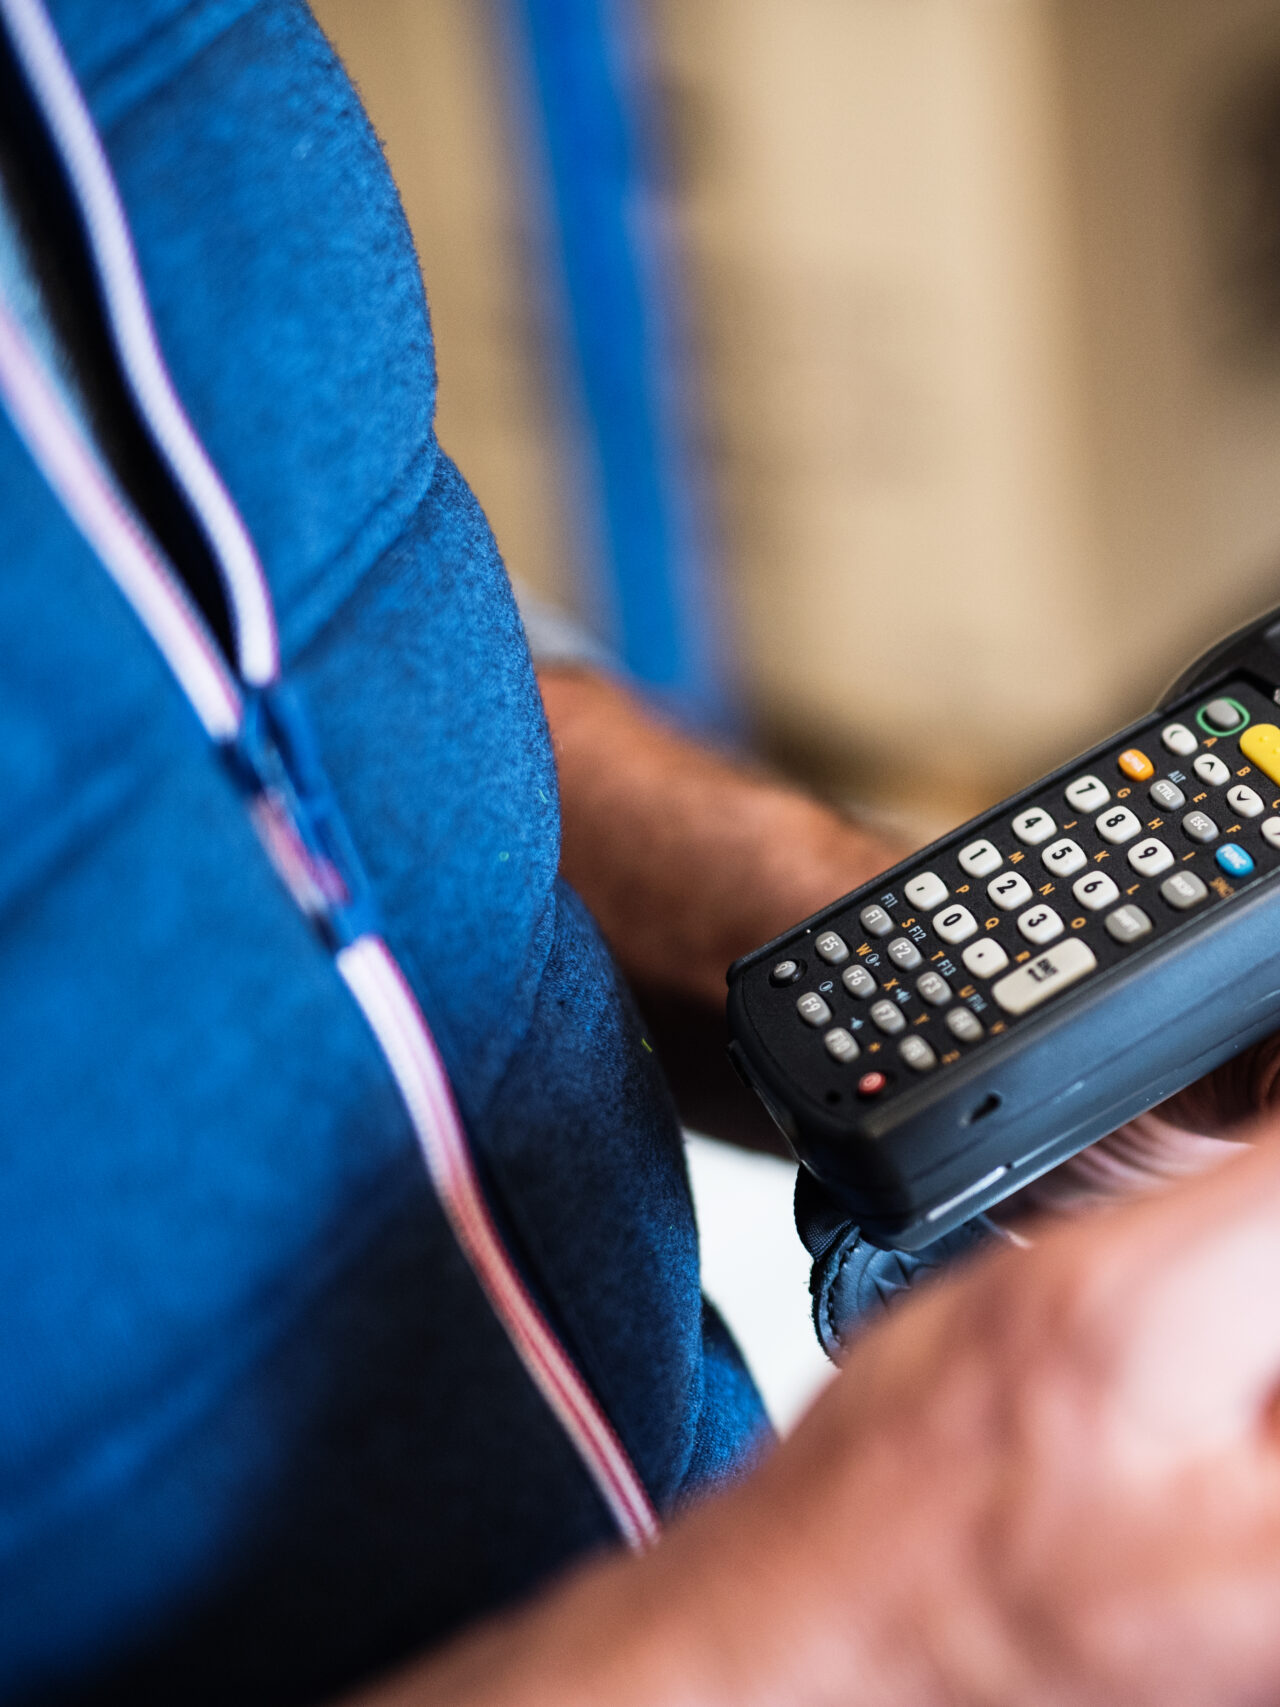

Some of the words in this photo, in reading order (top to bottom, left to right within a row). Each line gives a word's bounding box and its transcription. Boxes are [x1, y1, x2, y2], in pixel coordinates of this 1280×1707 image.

[1203, 737, 1218, 748] A
[1168, 770, 1186, 783] ALT
[1236, 766, 1251, 776] B
[1076, 782, 1096, 794] 7
[1117, 787, 1131, 798] G
[1156, 783, 1175, 800] CTRL
[1193, 792, 1207, 803] E
[1025, 817, 1042, 829] 4
[1063, 820, 1077, 829] J
[1106, 814, 1125, 827] 8
[1147, 817, 1164, 830] H
[1190, 816, 1208, 830] ESC
[1226, 824, 1241, 833] F
[970, 848, 987, 860] 1
[1008, 851, 1024, 864] M
[1052, 846, 1072, 860] 5
[1094, 850, 1110, 862] K
[1139, 847, 1157, 859] 9
[1182, 851, 1195, 861] I
[956, 884, 969, 893] P
[996, 880, 1017, 894] 2
[1039, 883, 1055, 895] N
[1084, 881, 1103, 893] 6
[1126, 884, 1139, 895] L
[881, 893, 898, 908] F11
[865, 909, 882, 924] F1
[902, 918, 915, 928] S
[1028, 913, 1047, 927] 3
[1071, 917, 1086, 929] O
[985, 917, 999, 930] Q
[908, 925, 927, 942] F12
[820, 936, 839, 951] F5
[856, 942, 872, 956] W
[893, 942, 911, 959] F2
[931, 951, 945, 960] T
[937, 959, 956, 976] F13
[847, 969, 867, 986] F6
[883, 978, 899, 991] X
[921, 977, 941, 994] F3
[959, 985, 976, 998] U
[801, 997, 821, 1013] F9
[875, 1004, 897, 1020] F7
